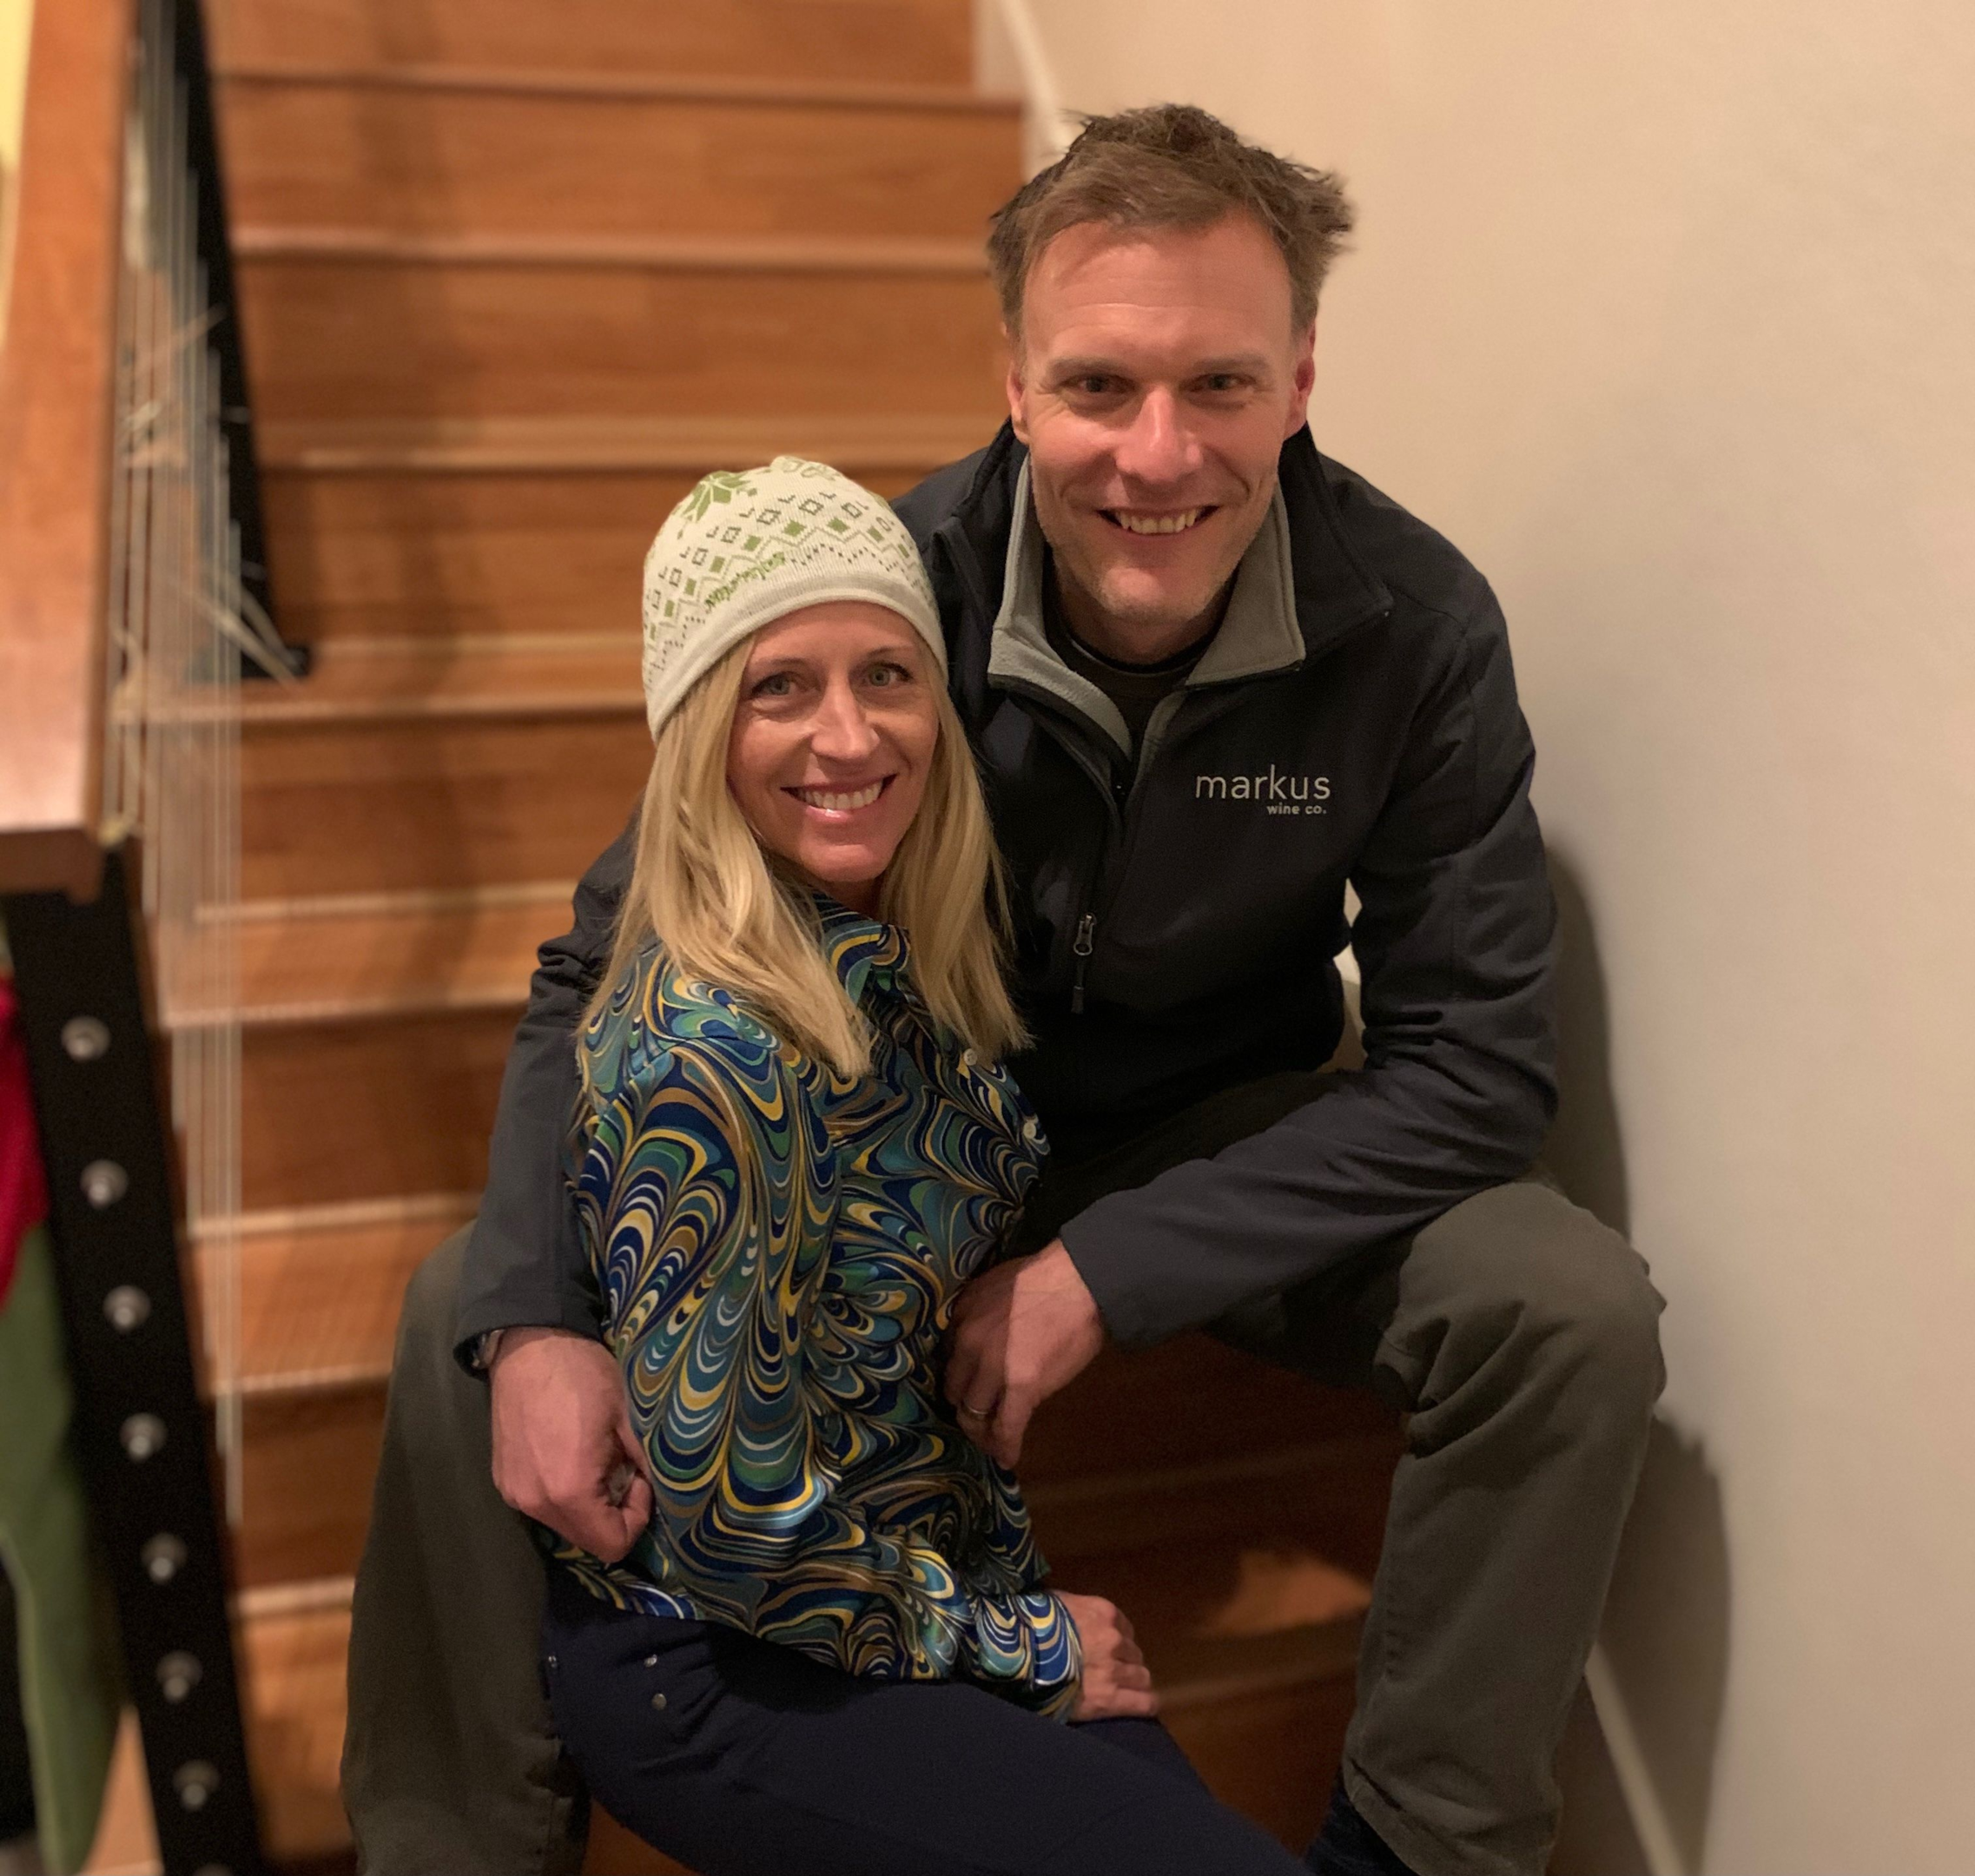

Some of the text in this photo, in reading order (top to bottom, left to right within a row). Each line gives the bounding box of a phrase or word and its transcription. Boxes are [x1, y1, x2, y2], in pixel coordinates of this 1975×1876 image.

[1195, 763, 1331, 800] markus
[1266, 803, 1327, 815] wine co.
